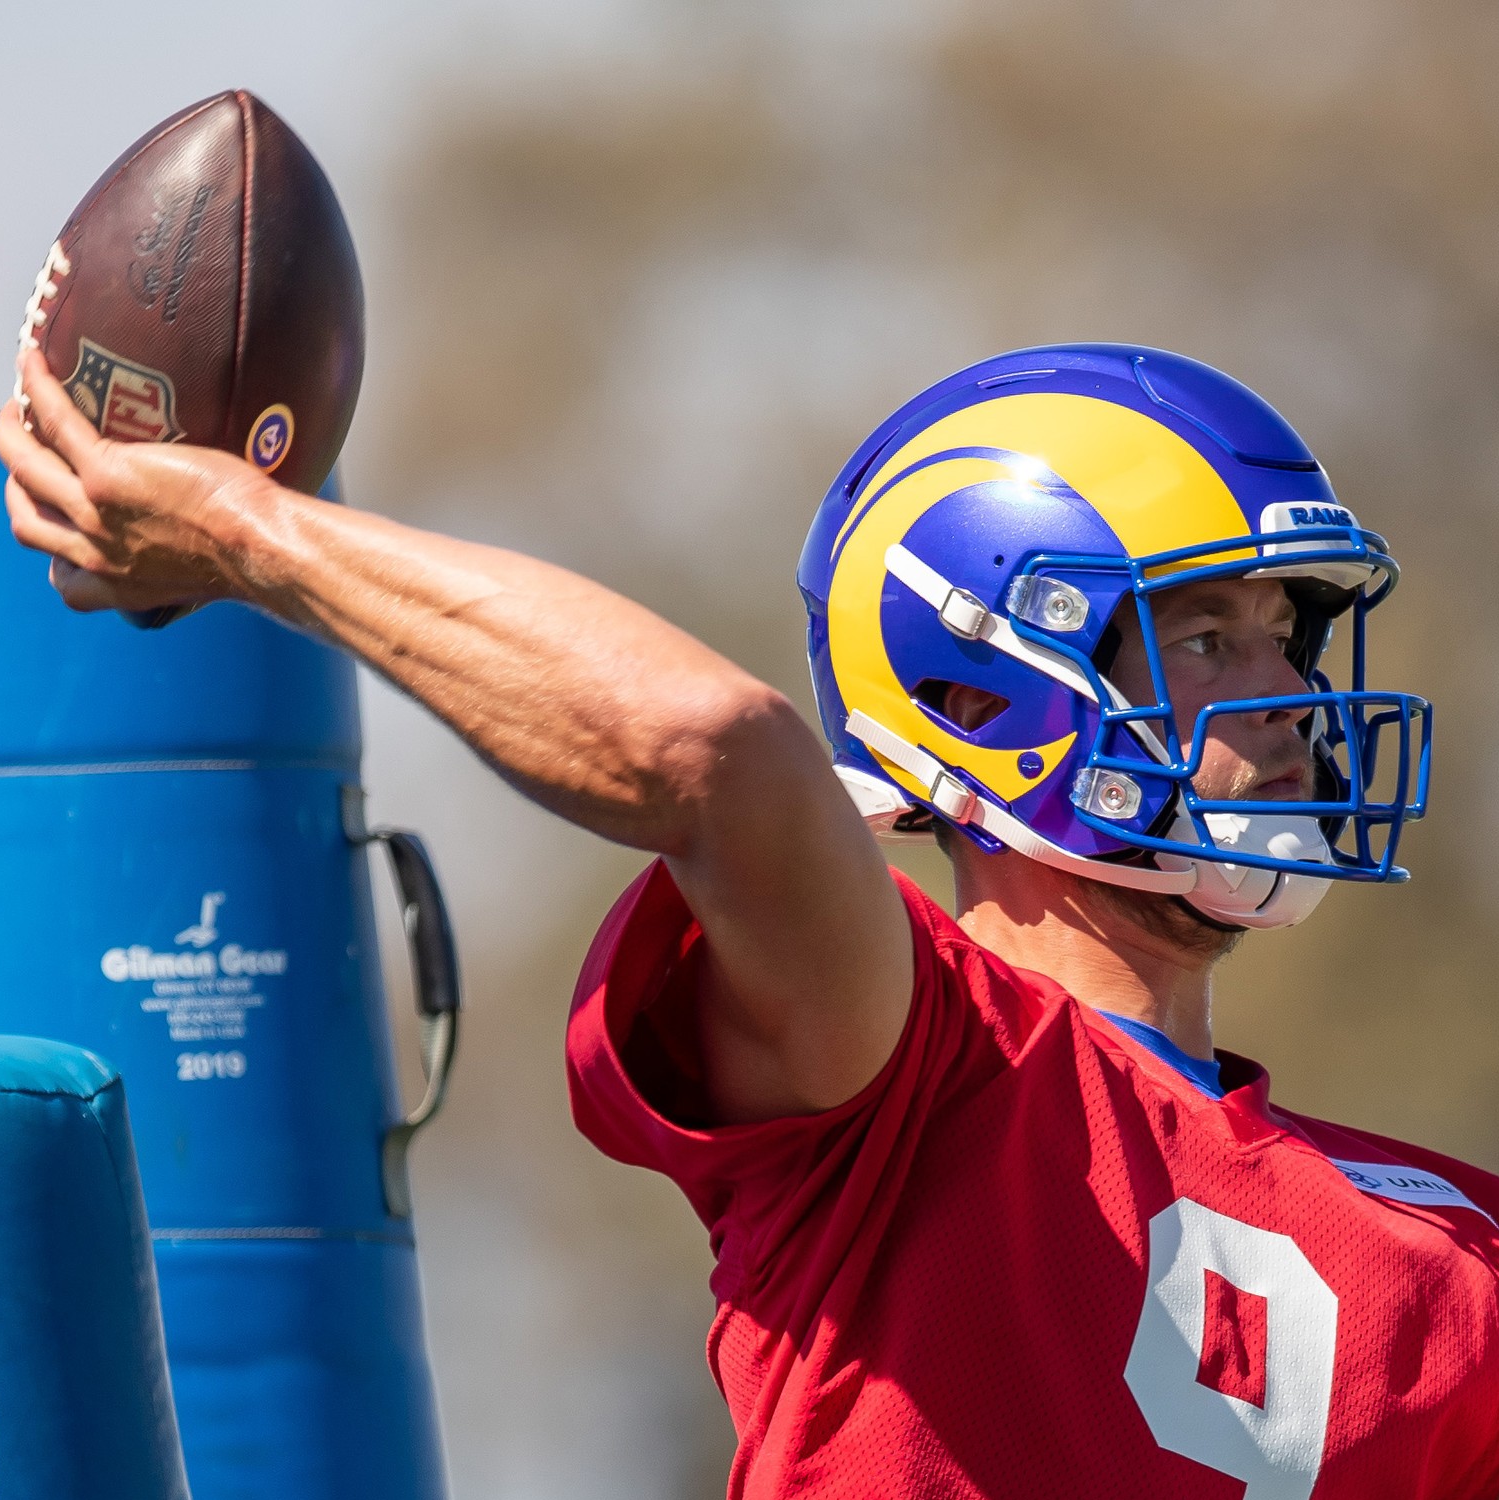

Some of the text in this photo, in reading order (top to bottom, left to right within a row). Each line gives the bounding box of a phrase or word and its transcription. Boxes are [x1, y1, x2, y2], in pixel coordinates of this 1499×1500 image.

[1288, 507, 1353, 527] RAMS
[101, 945, 217, 981] Gilman
[176, 1052, 246, 1081] 2019
